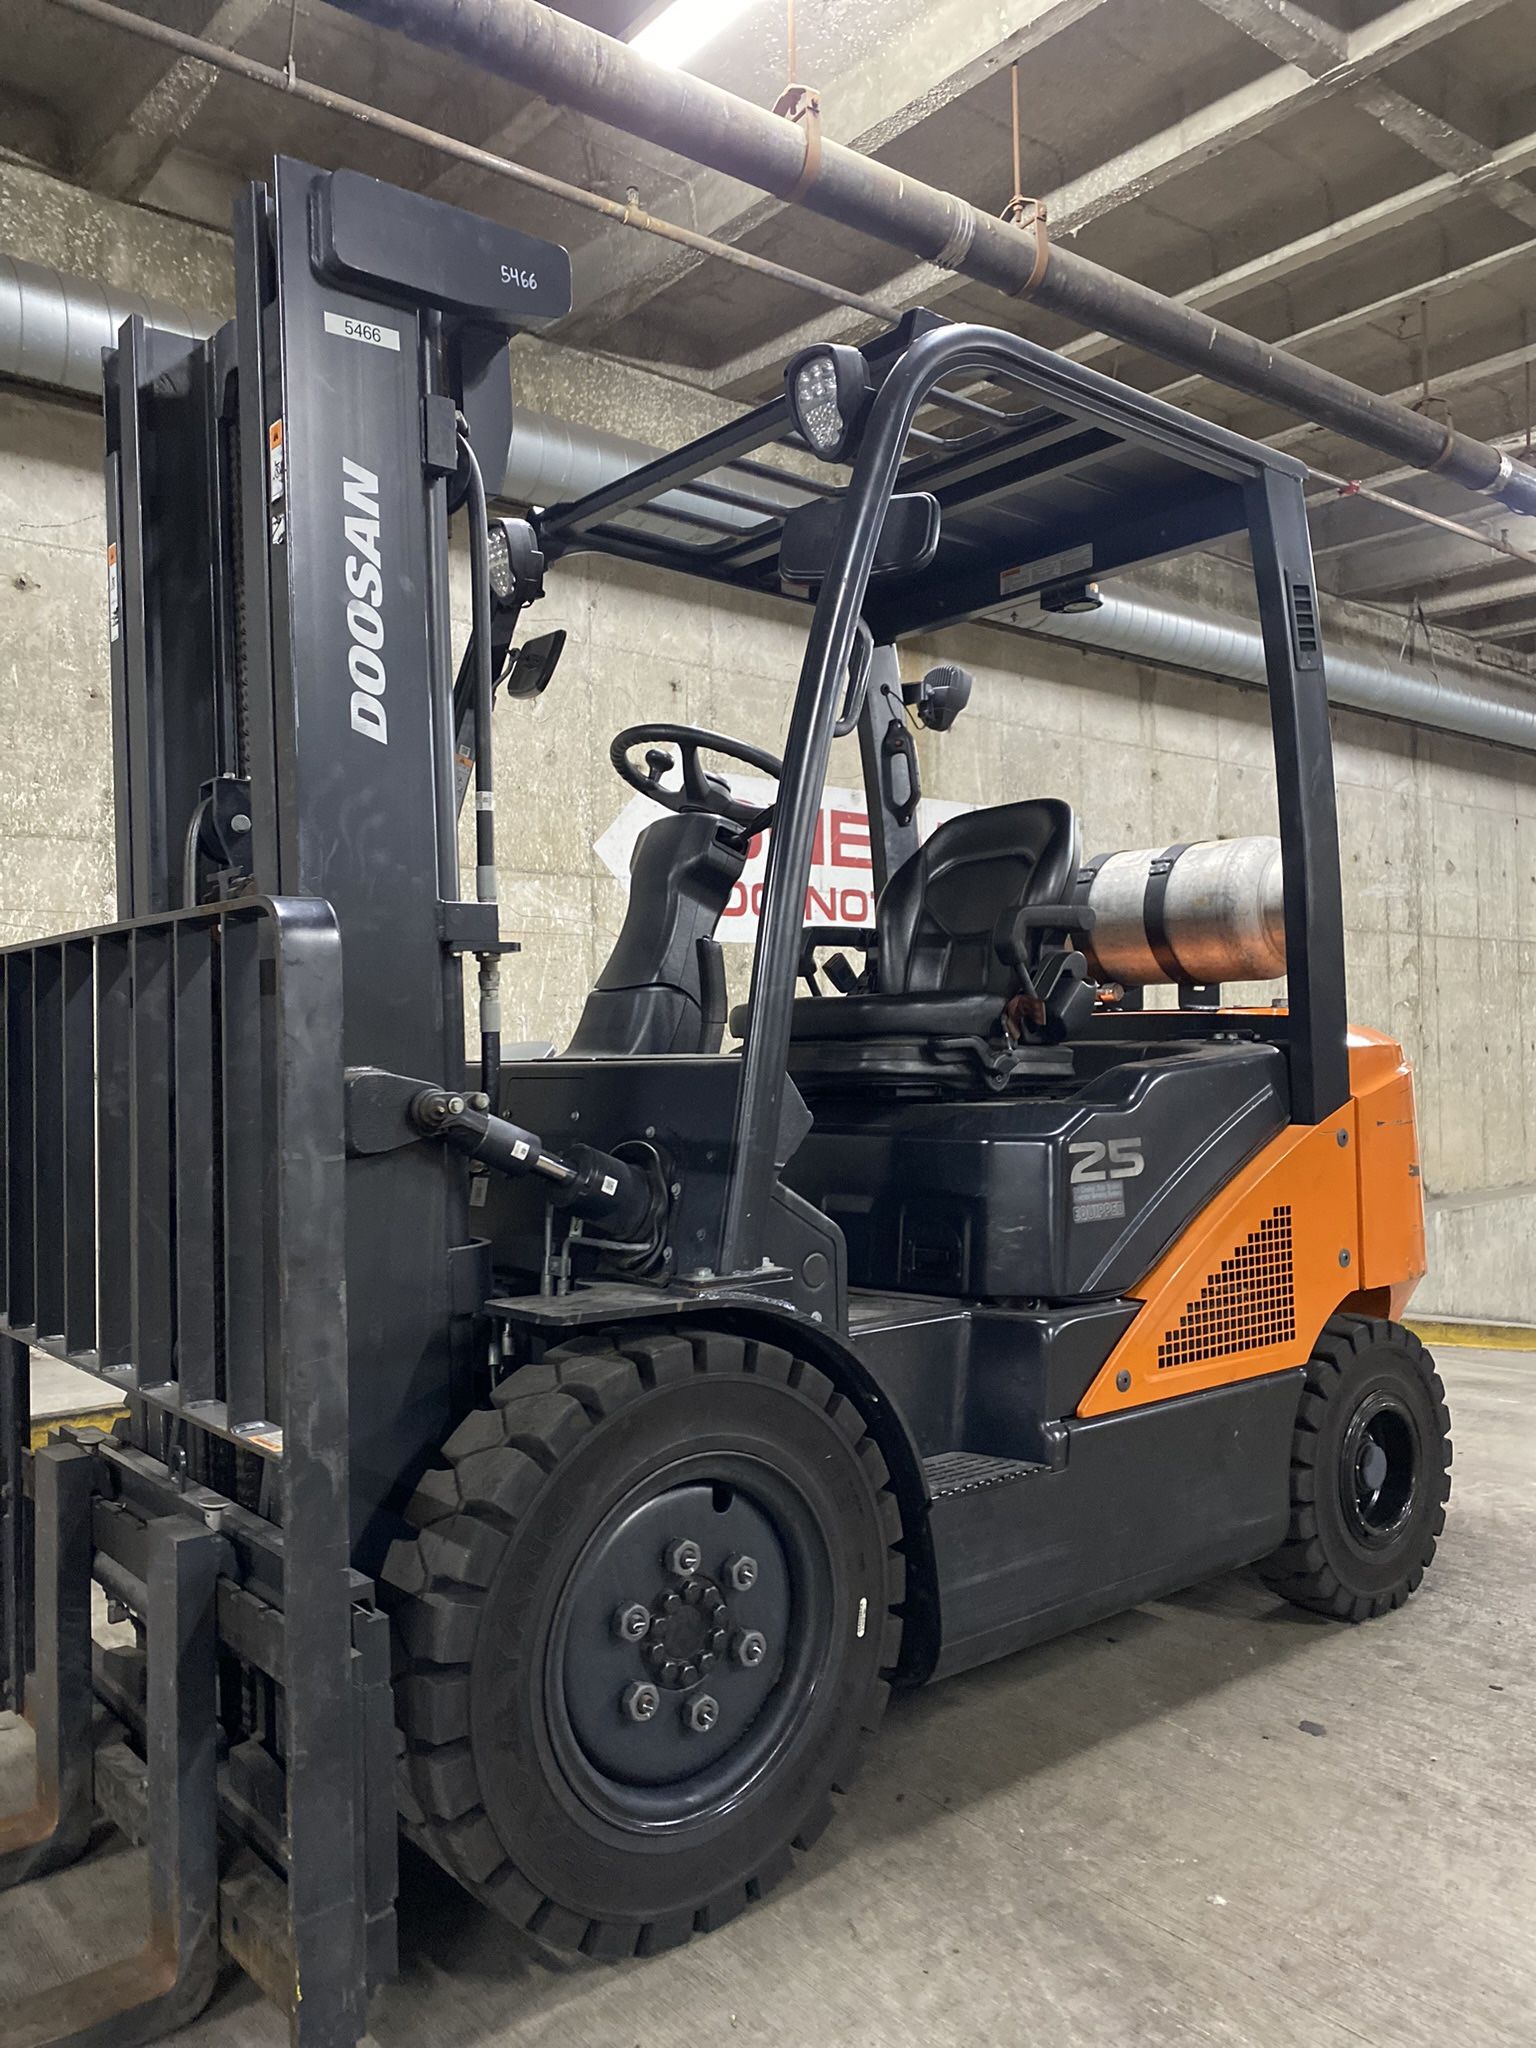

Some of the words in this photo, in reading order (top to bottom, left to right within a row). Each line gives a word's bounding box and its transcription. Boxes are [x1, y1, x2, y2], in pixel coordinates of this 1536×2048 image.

[501, 264, 538, 290] 5466
[344, 320, 382, 343] 5466
[342, 456, 388, 745] DOOSAN
[805, 886, 875, 922] NO
[1069, 1137, 1145, 1184] 25
